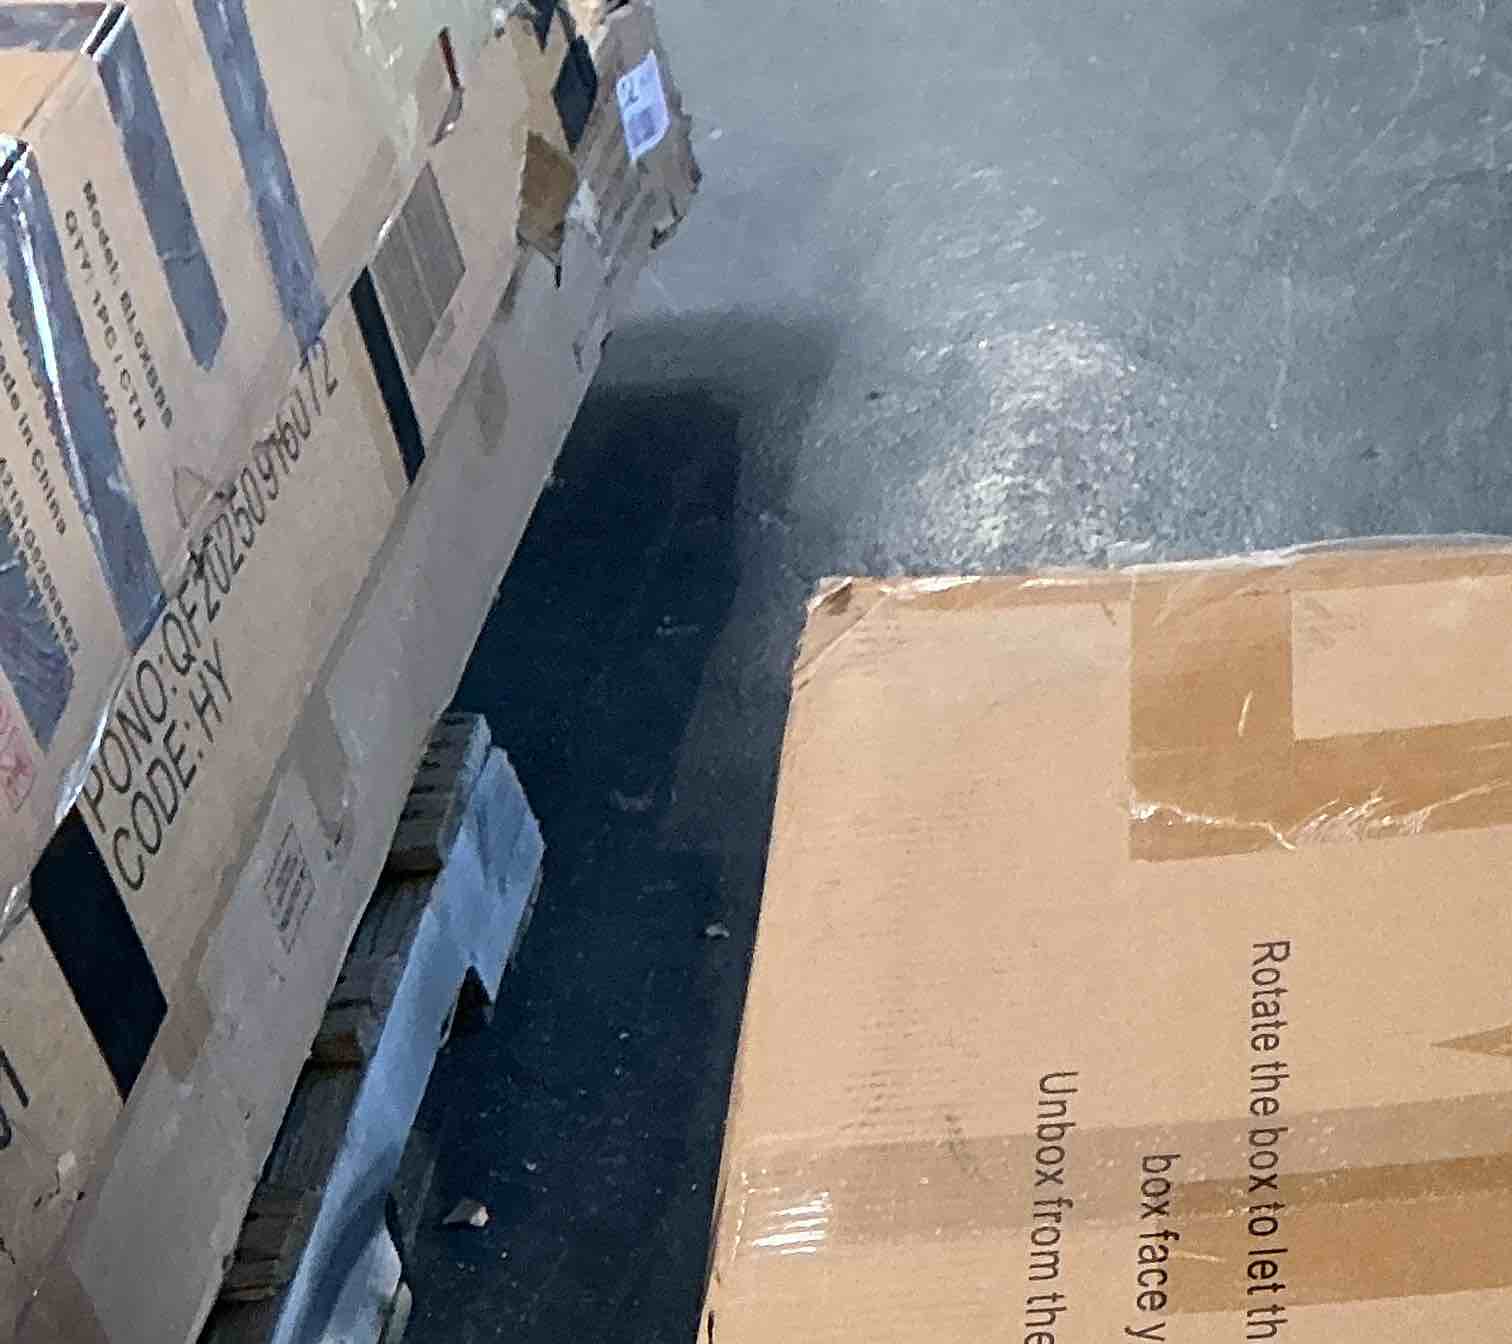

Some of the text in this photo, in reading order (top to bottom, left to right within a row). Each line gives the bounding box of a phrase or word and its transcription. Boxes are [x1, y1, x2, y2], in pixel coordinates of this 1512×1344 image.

[1250, 939, 1291, 1052] Rotate
[1250, 1061, 1290, 1116] the
[1034, 1071, 1079, 1187] Unbox
[1247, 1127, 1288, 1194] box
[1141, 1153, 1181, 1219] box
[1248, 1201, 1286, 1237] to
[1028, 1197, 1074, 1281] from
[1136, 1225, 1180, 1313] face
[1247, 1248, 1288, 1295] let
